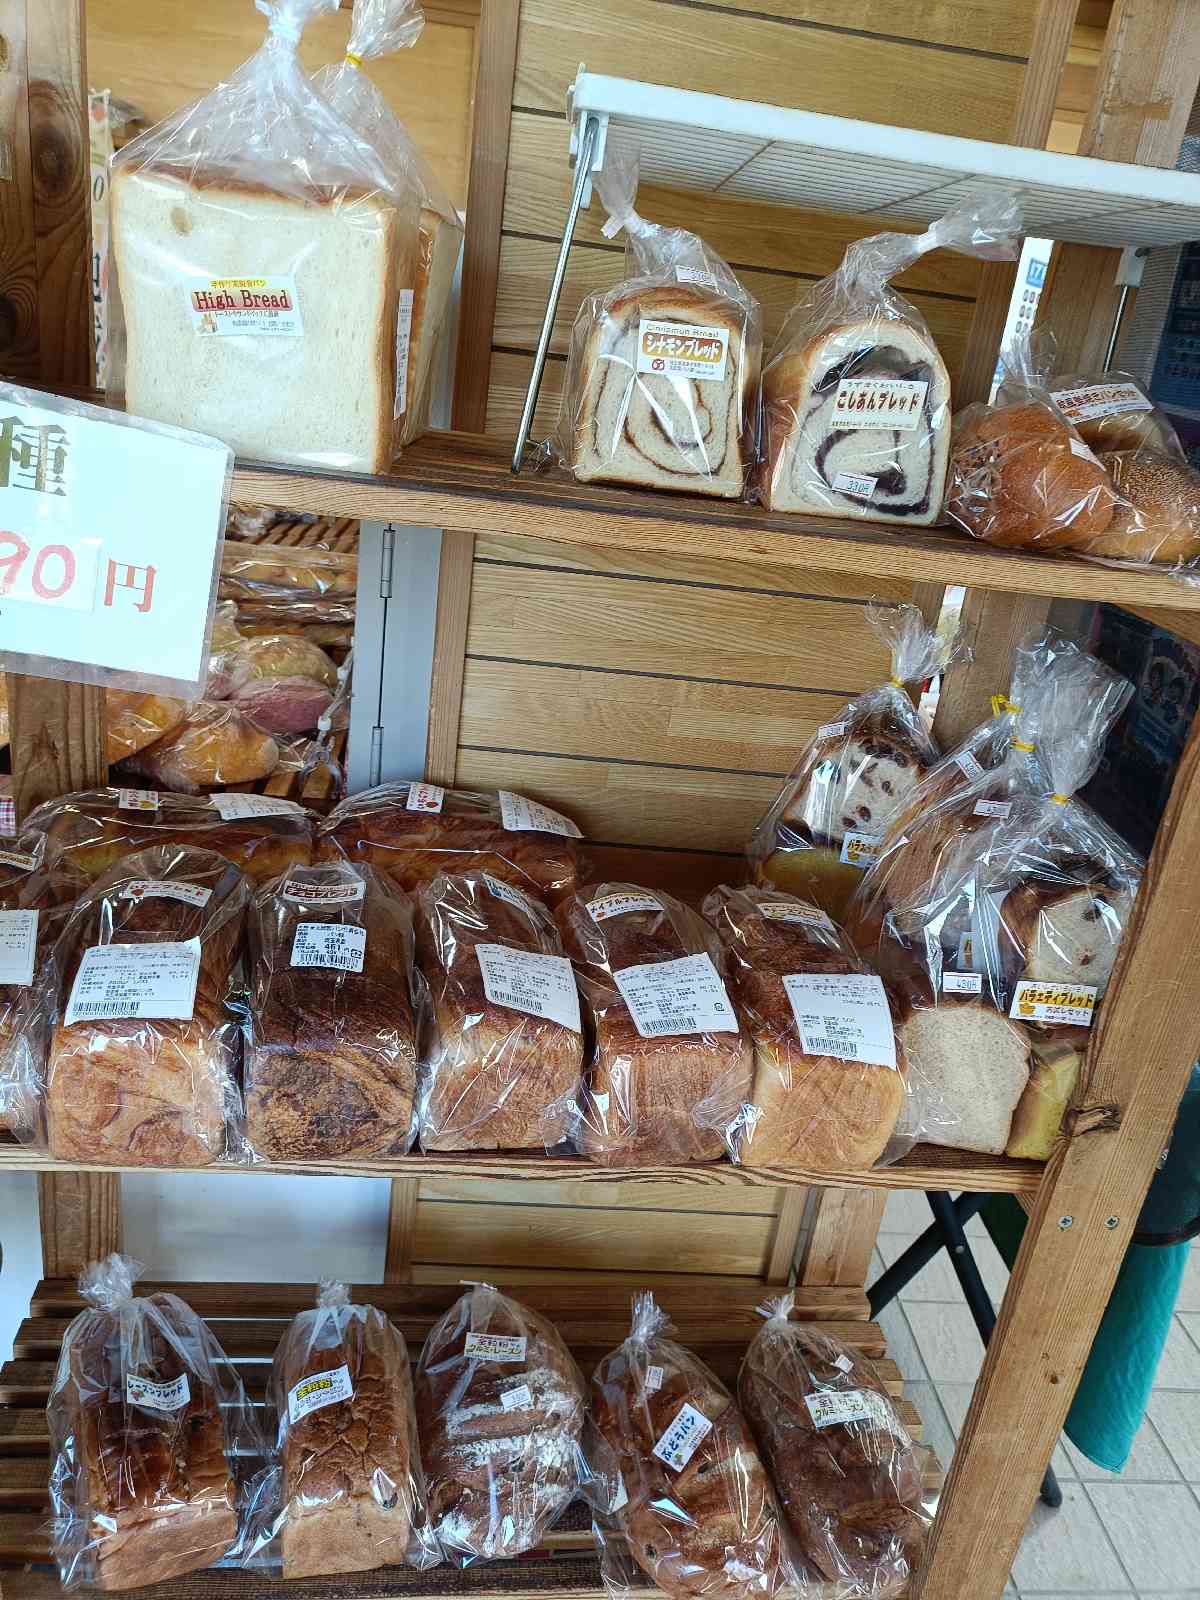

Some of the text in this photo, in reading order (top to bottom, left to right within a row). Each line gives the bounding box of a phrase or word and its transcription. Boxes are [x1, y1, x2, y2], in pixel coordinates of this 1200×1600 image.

[194, 289, 290, 310] High Bread
[646, 333, 722, 361] シナモンブレッド
[837, 390, 919, 413] こしあんブレッド
[1018, 989, 1094, 1008] バラエティブレッド
